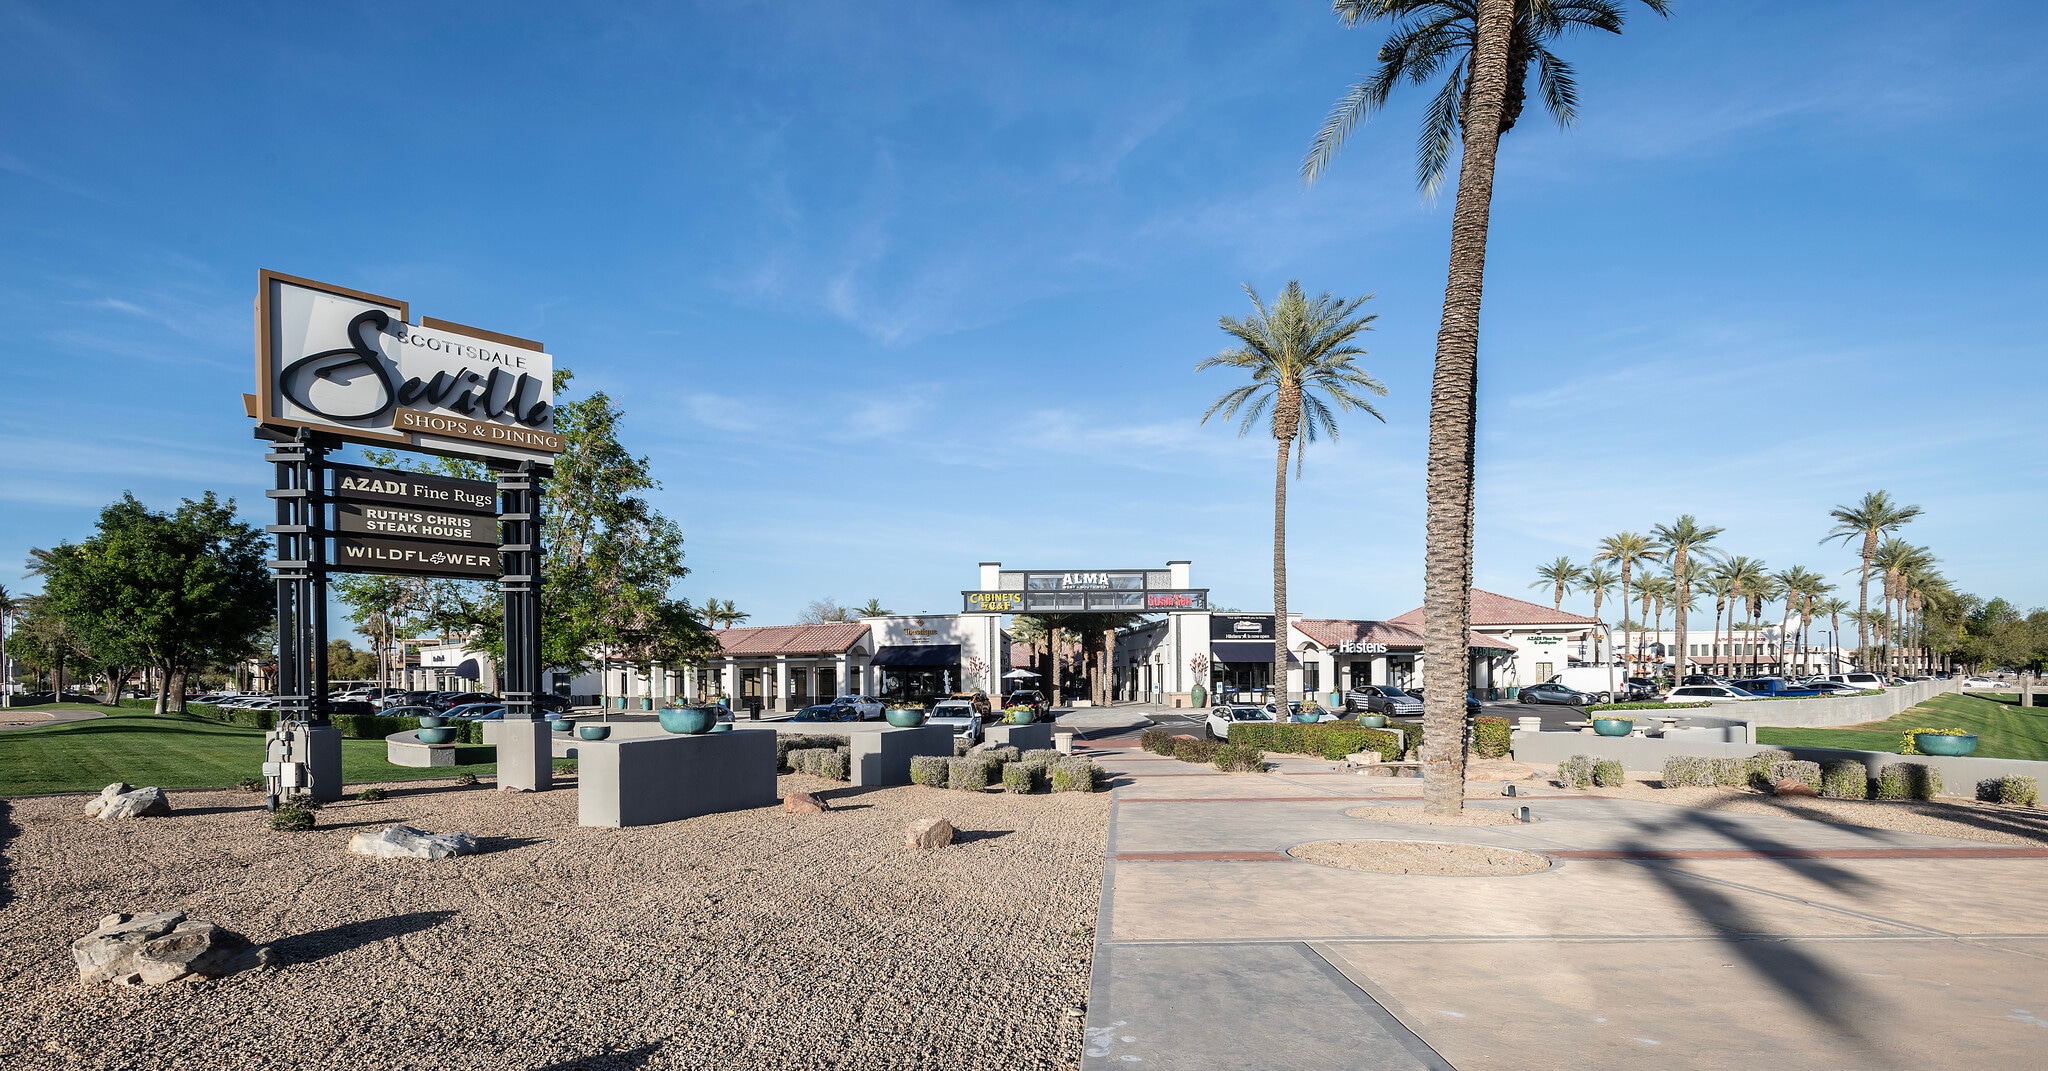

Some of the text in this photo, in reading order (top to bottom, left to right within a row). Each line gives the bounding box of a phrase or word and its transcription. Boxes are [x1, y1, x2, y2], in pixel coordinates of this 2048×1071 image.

[397, 331, 527, 369] SCOTTSDALE
[403, 413, 558, 448] SHOPS & DINING
[341, 476, 492, 508] AZADI Fine Rugs
[366, 508, 472, 528] RUTH'S CHRIS
[366, 521, 472, 539] STEAK HOUSE
[1062, 573, 1109, 586] ALMA
[969, 593, 1021, 604] CABINETS
[1147, 594, 1174, 607] Sushi
[989, 601, 1011, 611] C&F
[1339, 639, 1387, 653] Hästens
[1470, 647, 1488, 656] AZADI
